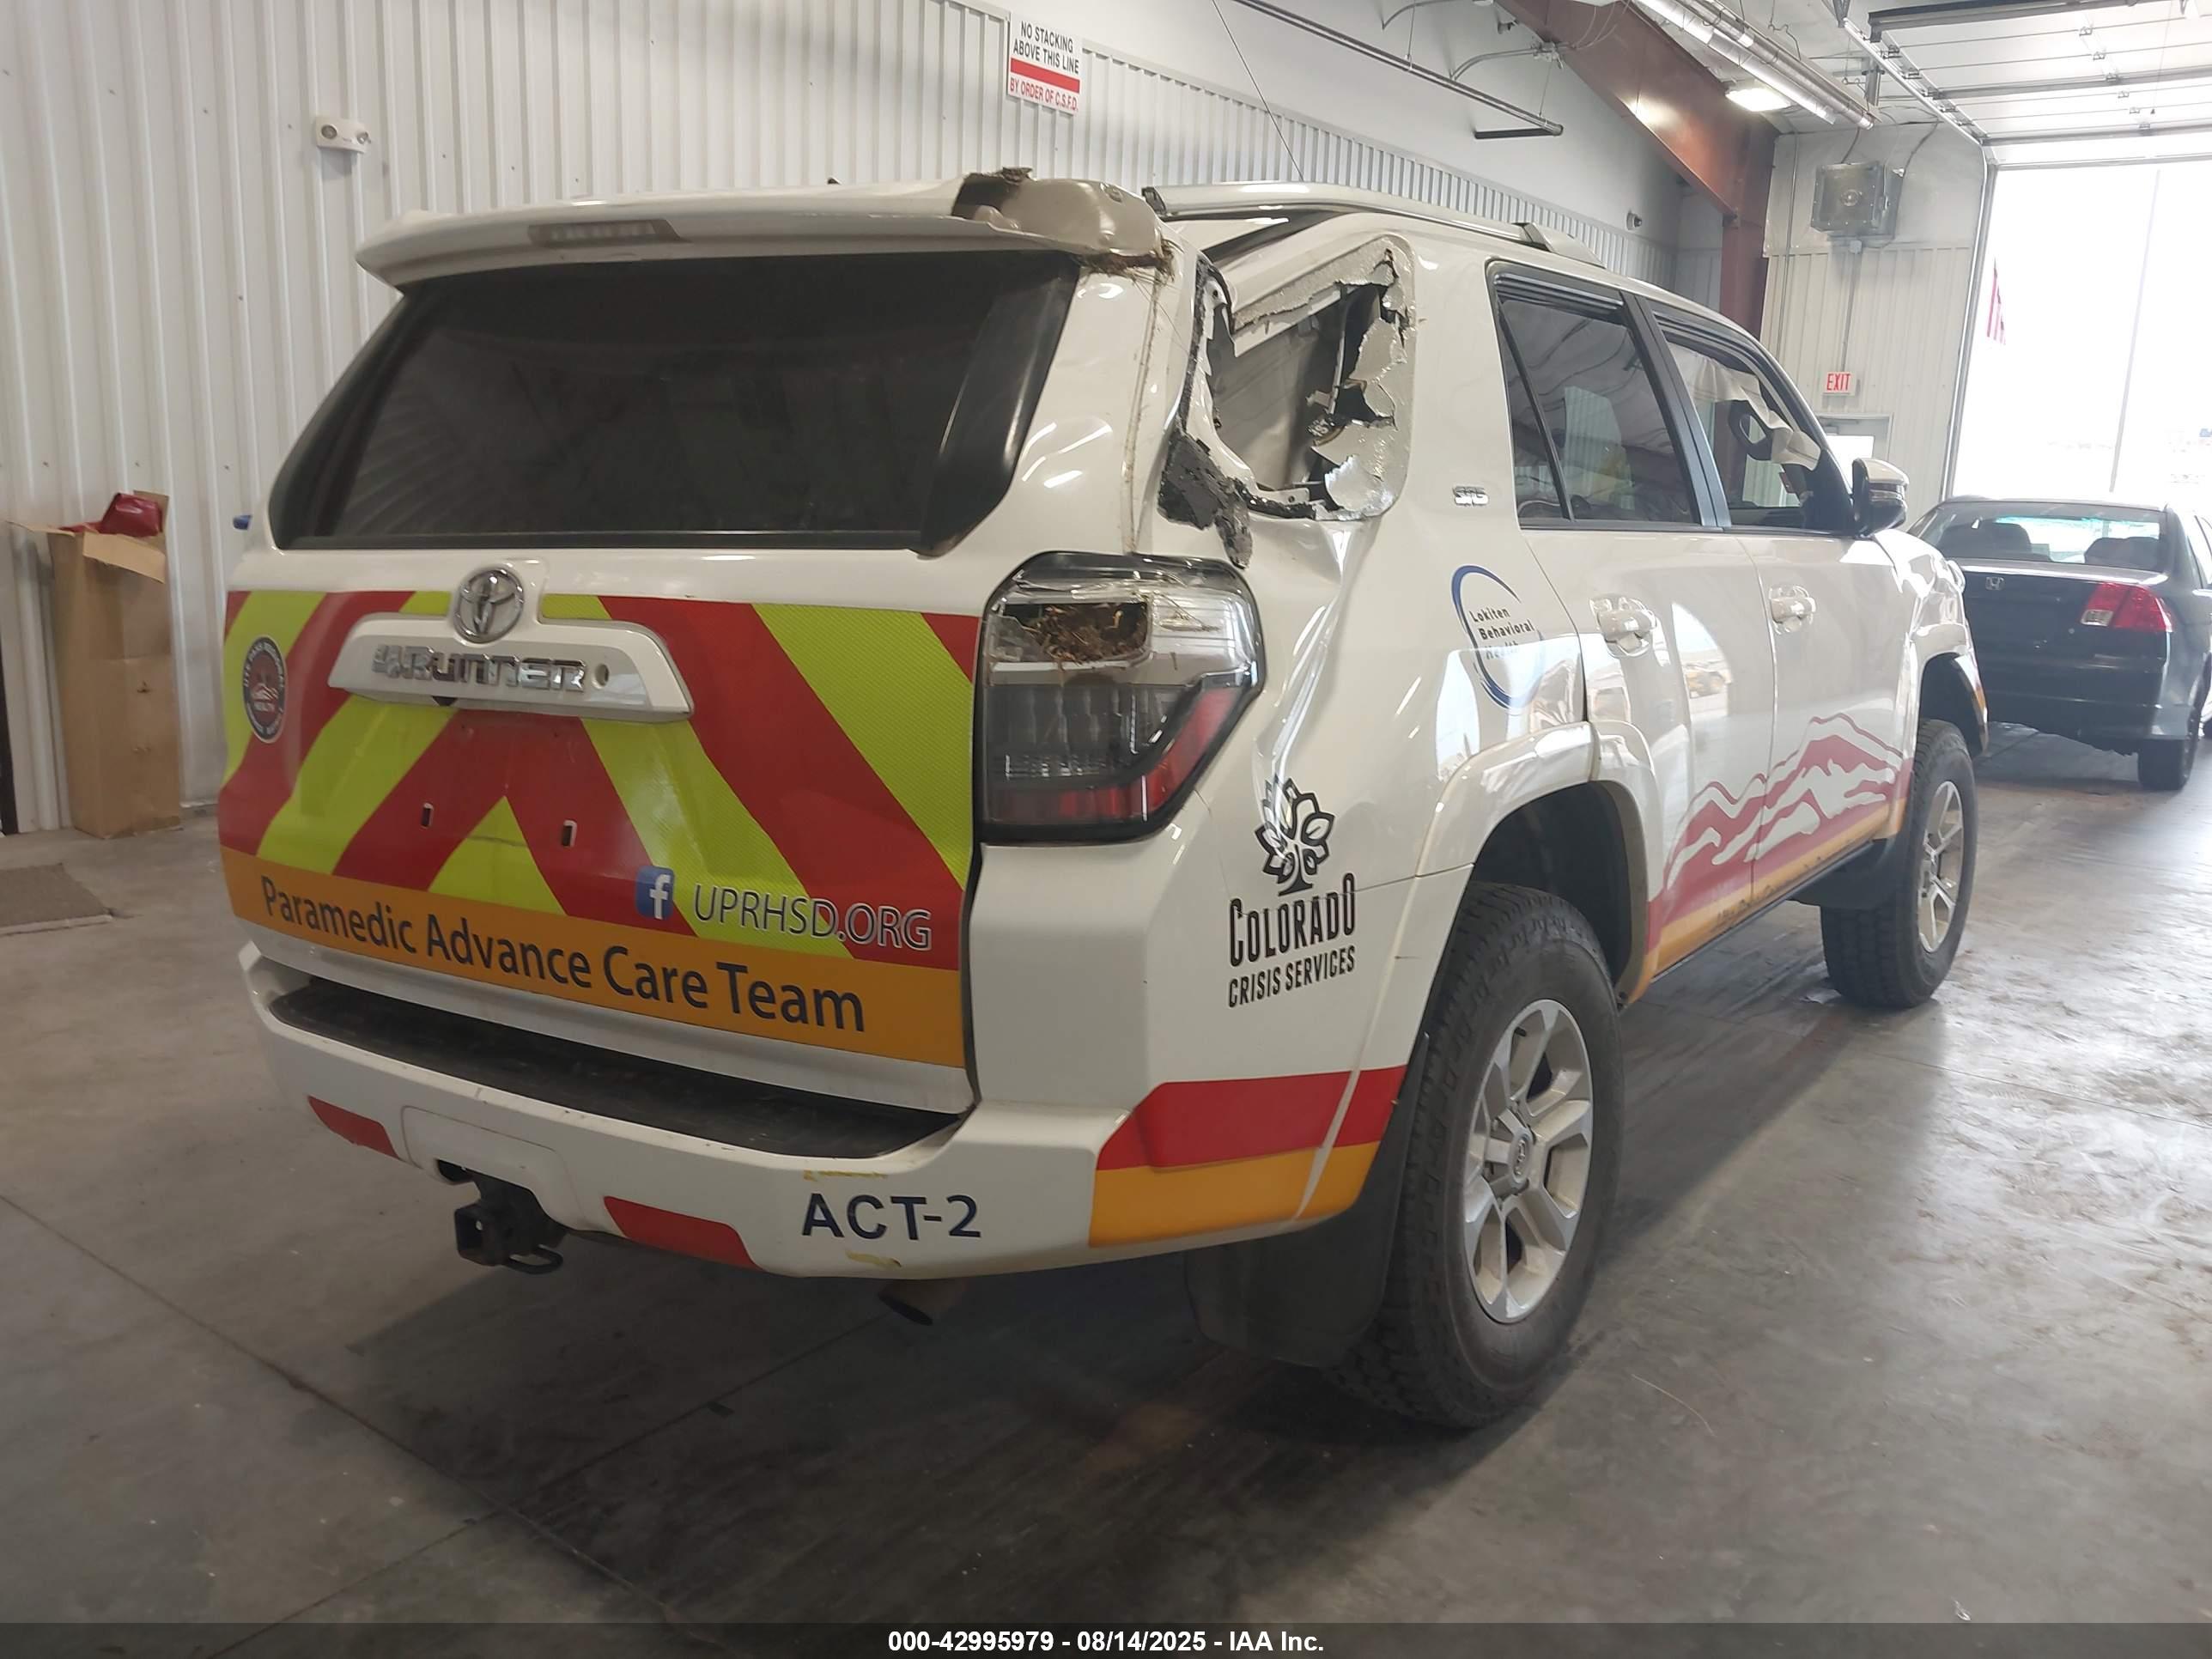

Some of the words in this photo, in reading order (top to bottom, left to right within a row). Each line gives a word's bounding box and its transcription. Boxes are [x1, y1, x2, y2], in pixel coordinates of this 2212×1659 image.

[1021, 21, 1032, 39] NO
[1035, 27, 1073, 52] STACKING
[1013, 39, 1040, 62] ABOVE
[1042, 48, 1060, 68] THIS
[1062, 56, 1079, 74] LINE
[1010, 77, 1019, 93] BY
[1020, 81, 1043, 102] ORDER
[1045, 89, 1054, 104] OF
[1826, 373, 1850, 391] EXIT
[1469, 607, 1510, 622] Lokiten
[1479, 619, 1534, 640] Behavioral
[693, 884, 933, 951] UPRHSD.ORG
[1230, 872, 1355, 968] COLORADO
[261, 876, 417, 954] Paramedic
[428, 914, 592, 988] Advance
[603, 945, 708, 1009] Care
[716, 962, 865, 1031] Team
[1229, 965, 1281, 1008] CRISIS
[1285, 945, 1355, 991] SERVICES
[802, 1193, 981, 1240] ACT-2
